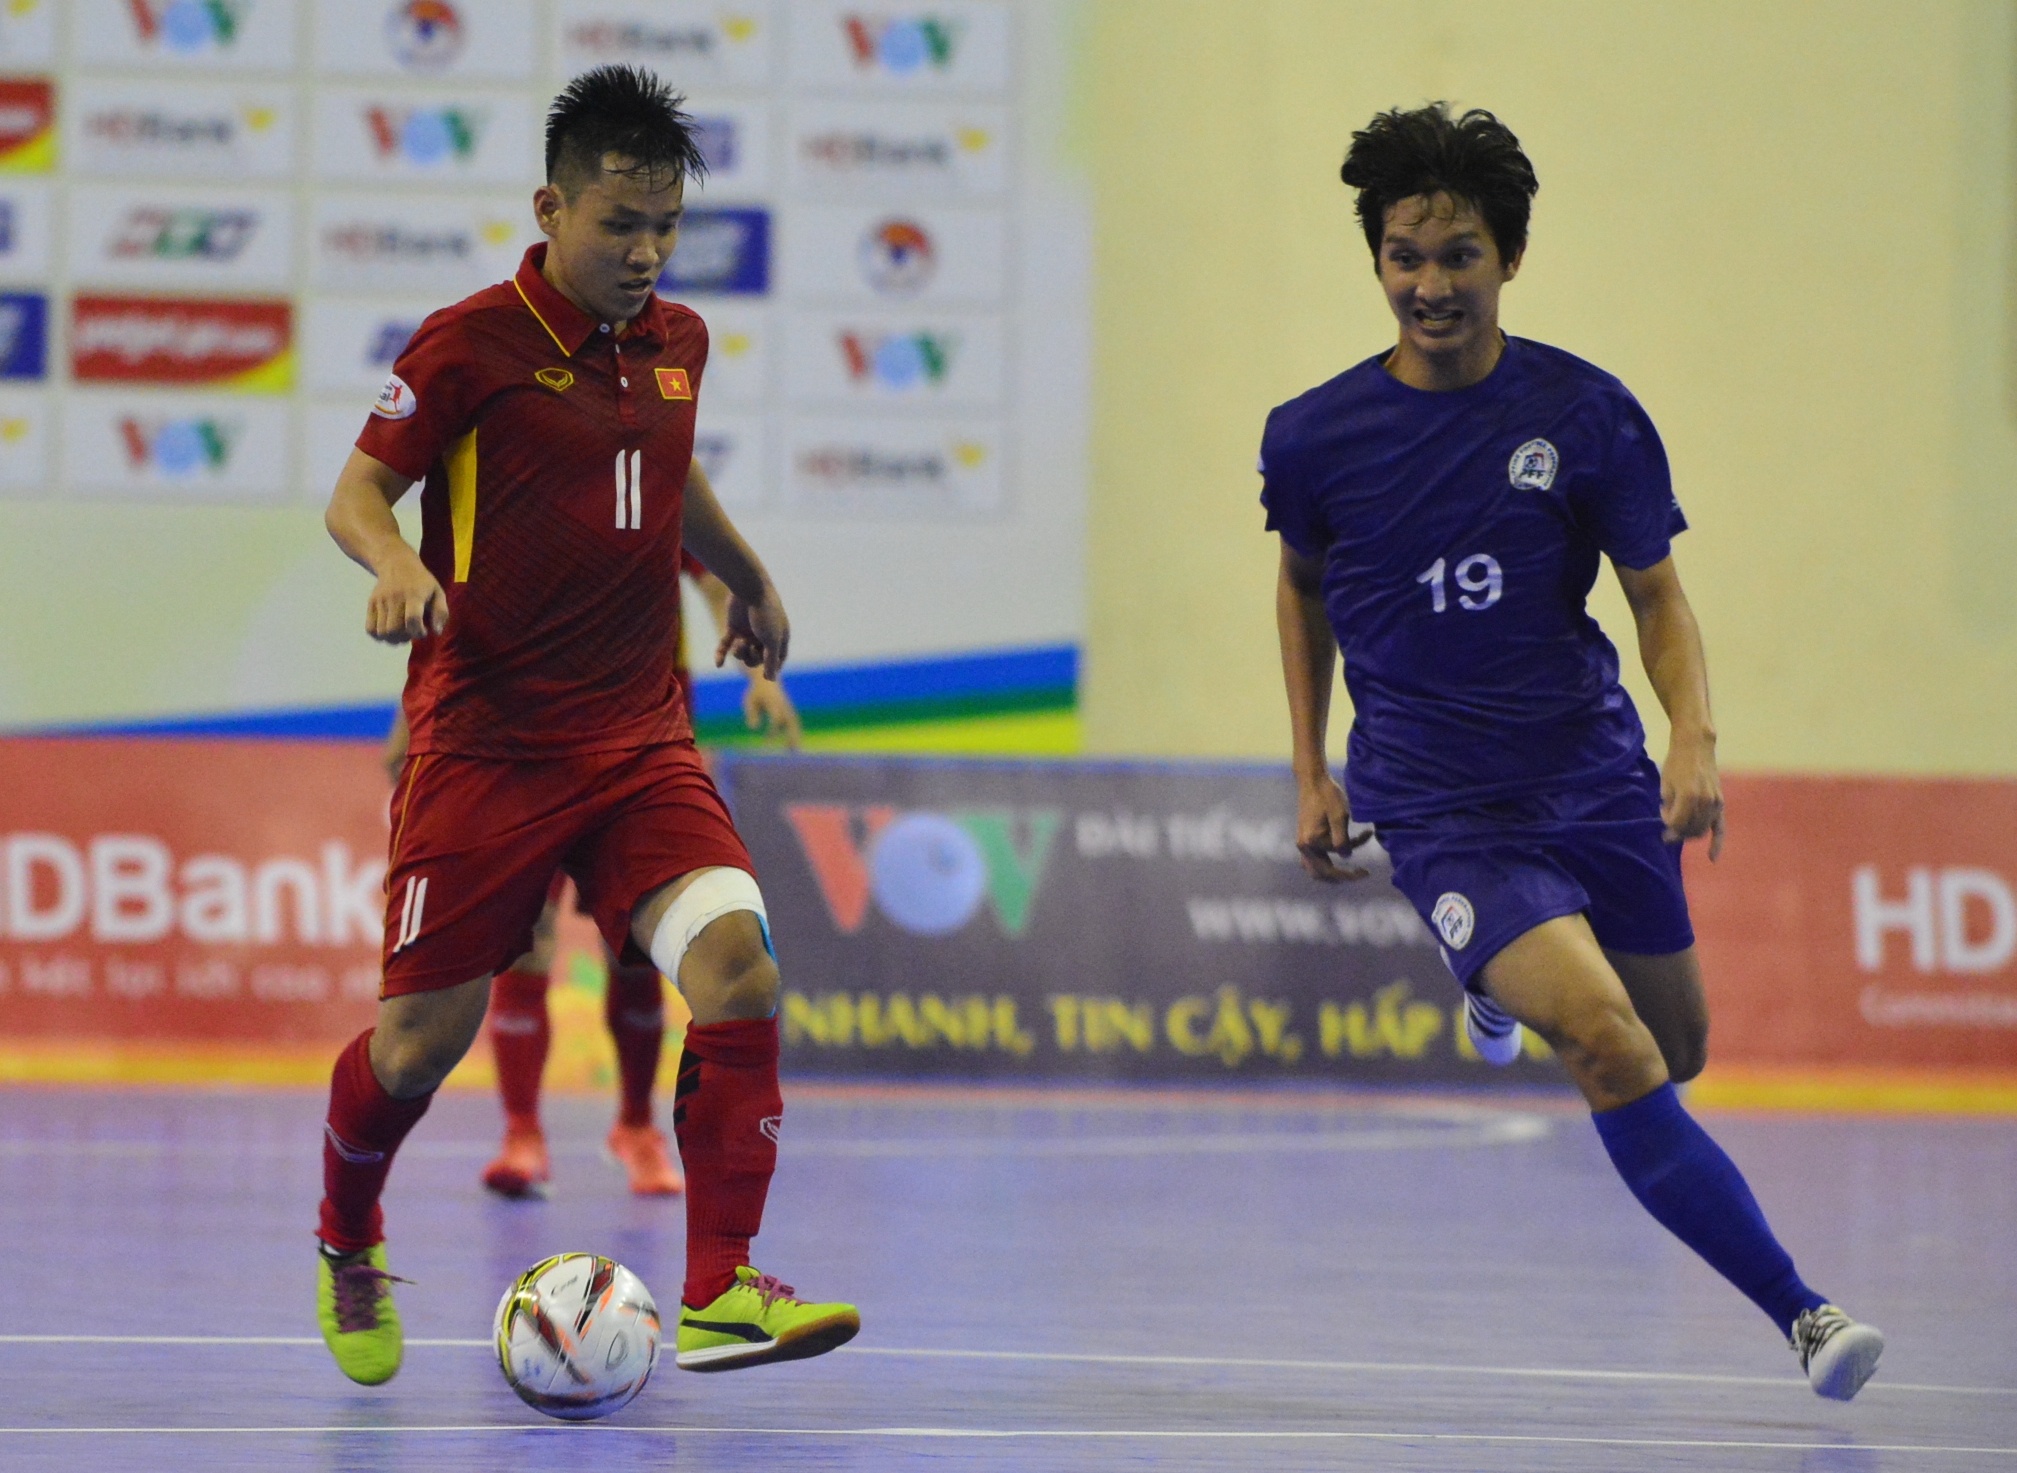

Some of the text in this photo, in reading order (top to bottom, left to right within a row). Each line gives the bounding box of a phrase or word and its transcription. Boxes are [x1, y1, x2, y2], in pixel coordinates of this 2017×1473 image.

[842, 13, 963, 74] VOV
[364, 105, 484, 163] VOV
[836, 328, 957, 391] VOV
[118, 414, 240, 476] VOV
[615, 449, 641, 529] 11
[1416, 553, 1503, 613] 19
[0, 831, 386, 947] DBank
[784, 803, 1061, 936] VOV
[393, 875, 428, 953] 11
[1851, 865, 2017, 974] HD
[783, 992, 1034, 1056] NHANH,
[1050, 994, 1155, 1054] TIN
